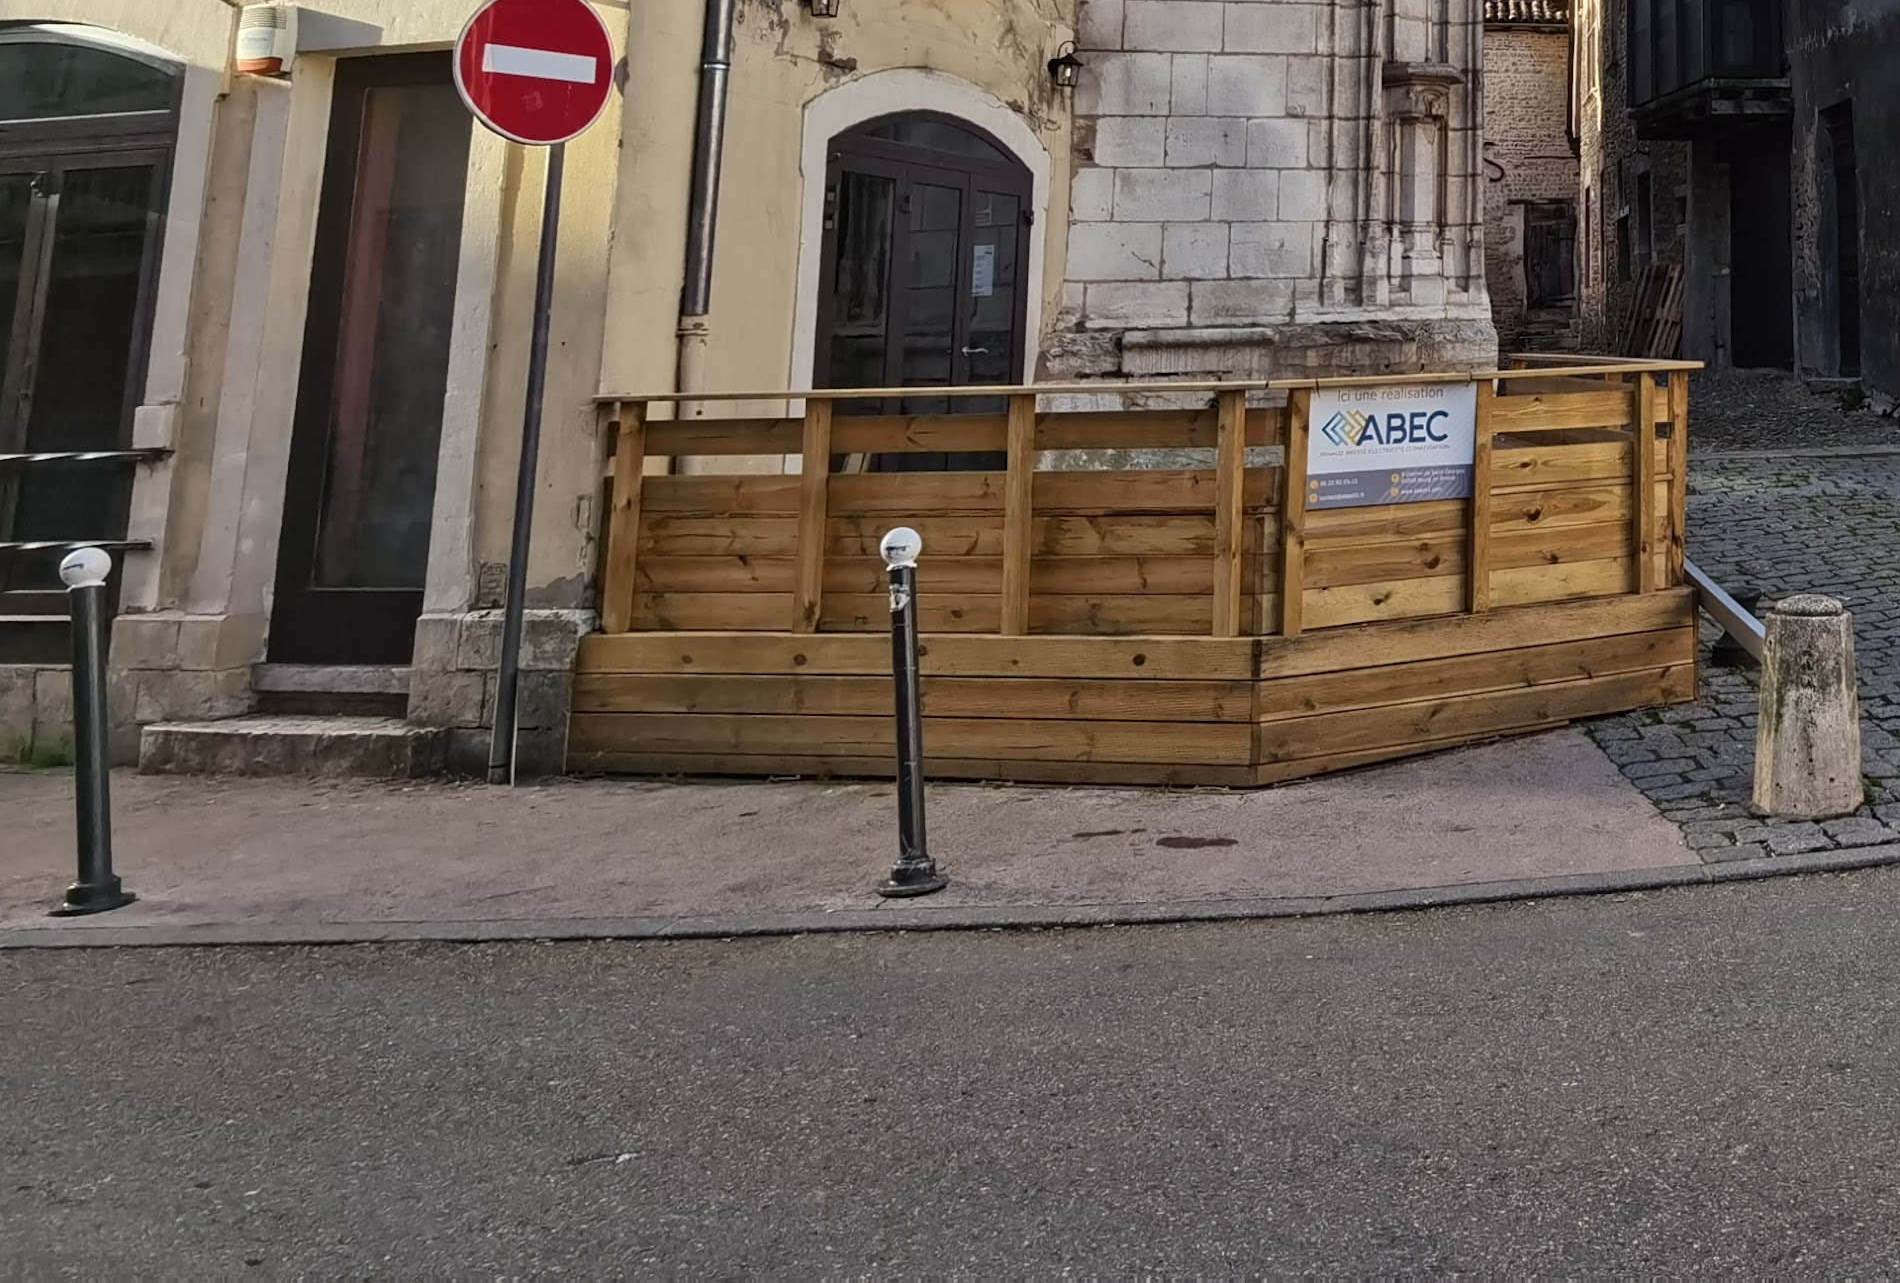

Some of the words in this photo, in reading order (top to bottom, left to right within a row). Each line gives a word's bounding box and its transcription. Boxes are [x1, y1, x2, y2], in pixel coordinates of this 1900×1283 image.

[1337, 390, 1350, 403] ici
[1355, 391, 1377, 402] une
[1381, 387, 1444, 401] réalisation
[1356, 410, 1449, 446] ABEC
